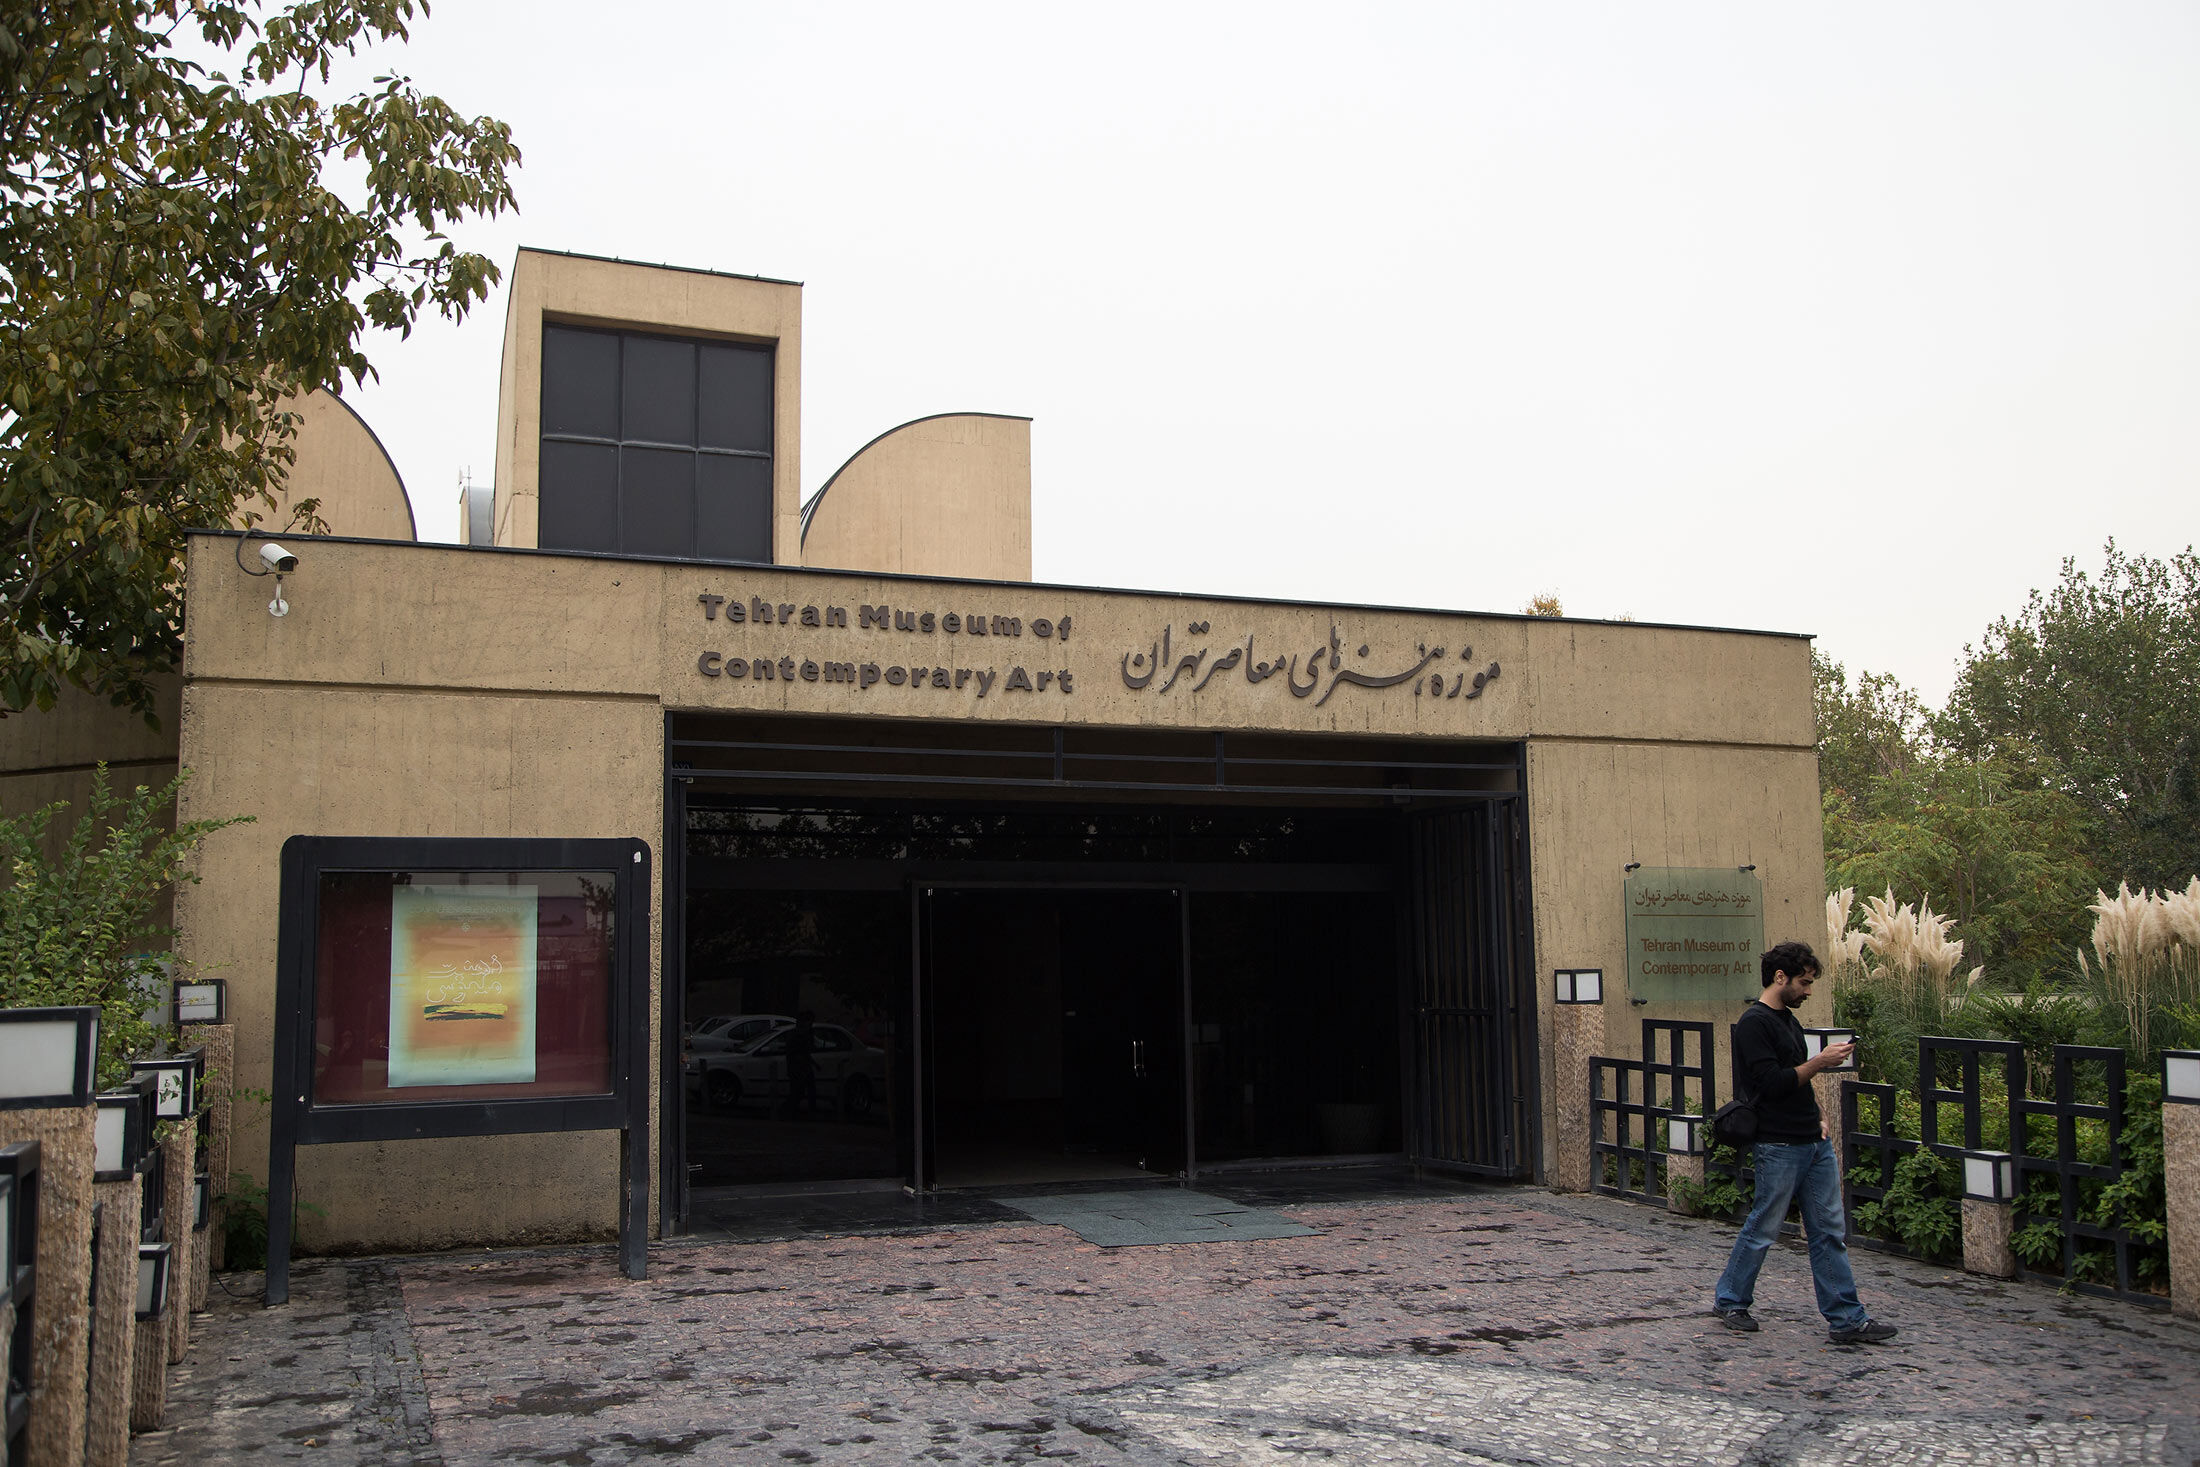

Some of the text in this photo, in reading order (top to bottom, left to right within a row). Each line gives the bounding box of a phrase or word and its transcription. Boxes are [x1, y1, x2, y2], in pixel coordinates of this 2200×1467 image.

[699, 593, 1072, 640] Tehran Museum of
[699, 650, 1073, 698] Contemporary Art
[1121, 620, 1501, 708] موزه هنرهای معاصر تهران
[1635, 888, 1751, 908] موزه هنرهای معاصر تهران
[1641, 938, 1751, 951] Tehran Museum of
[1642, 960, 1752, 976] Contemporary Art
